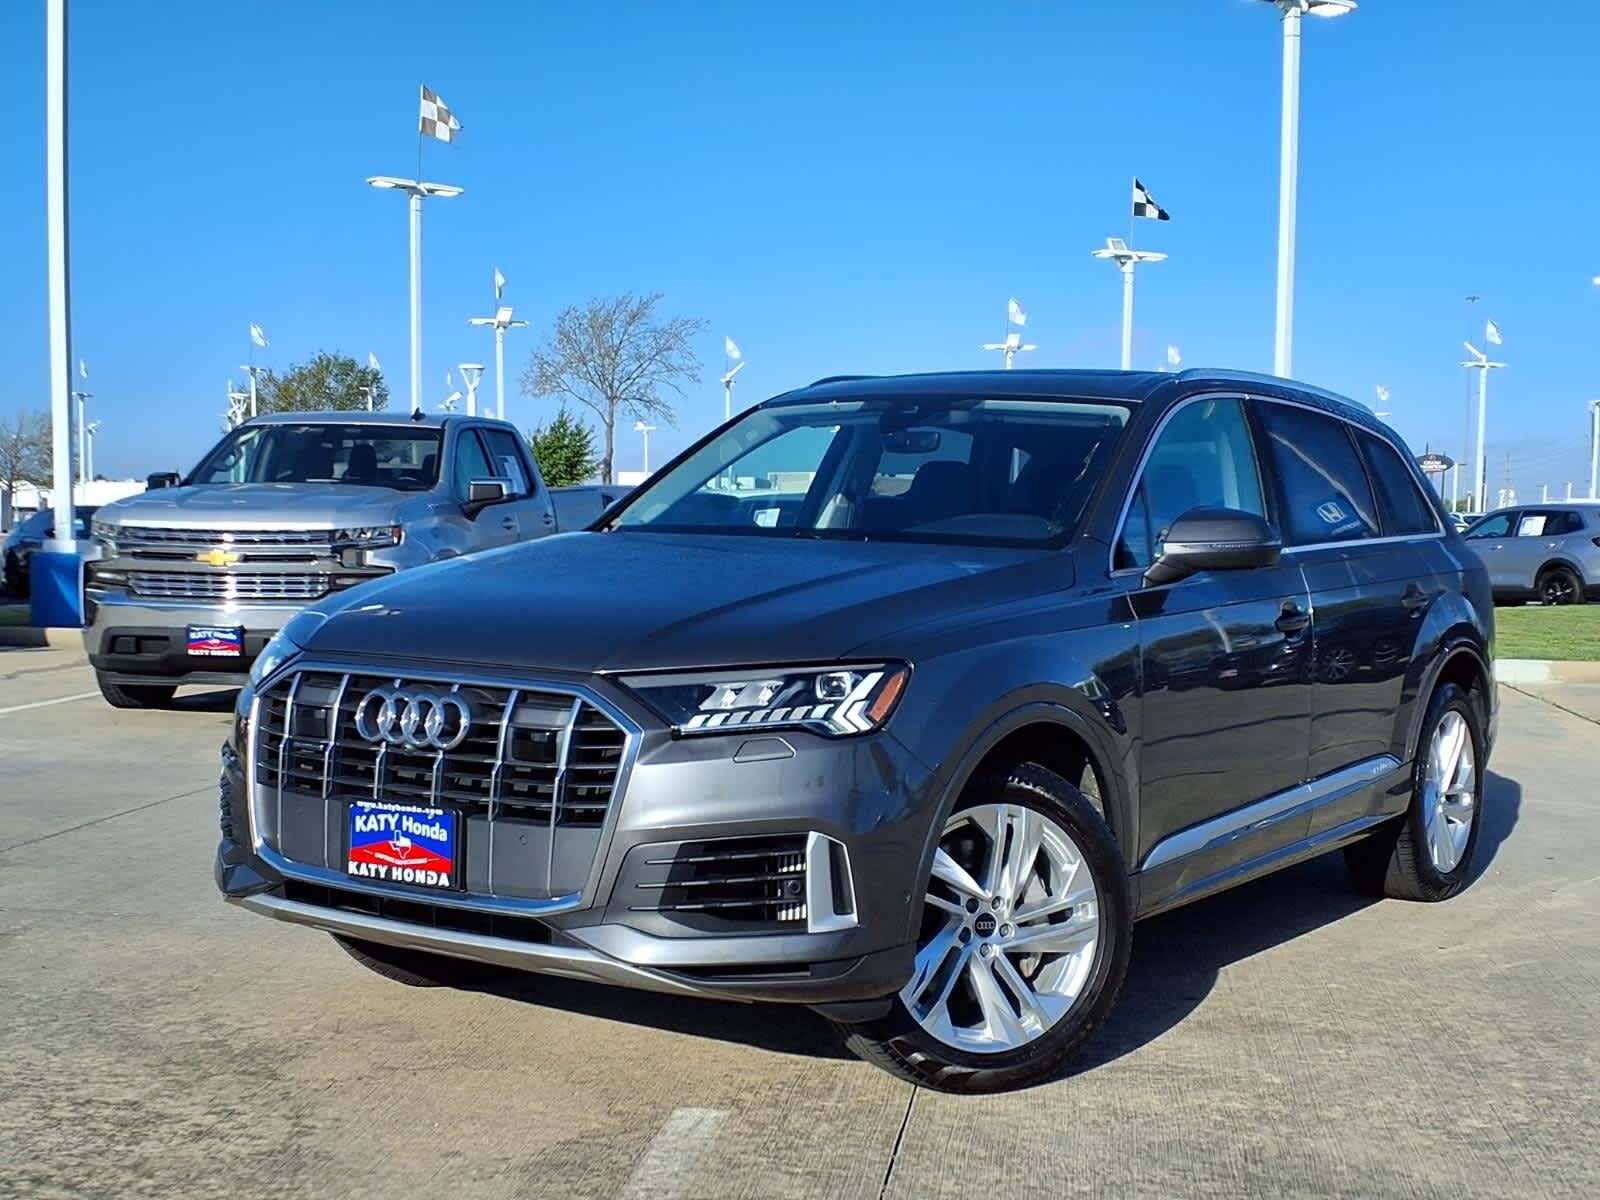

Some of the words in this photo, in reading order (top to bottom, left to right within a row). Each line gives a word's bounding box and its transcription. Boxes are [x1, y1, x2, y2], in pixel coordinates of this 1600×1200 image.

[355, 813, 400, 833] KATY
[402, 815, 448, 842] Honda
[348, 861, 388, 879] KATY
[391, 867, 450, 887] HONDA
